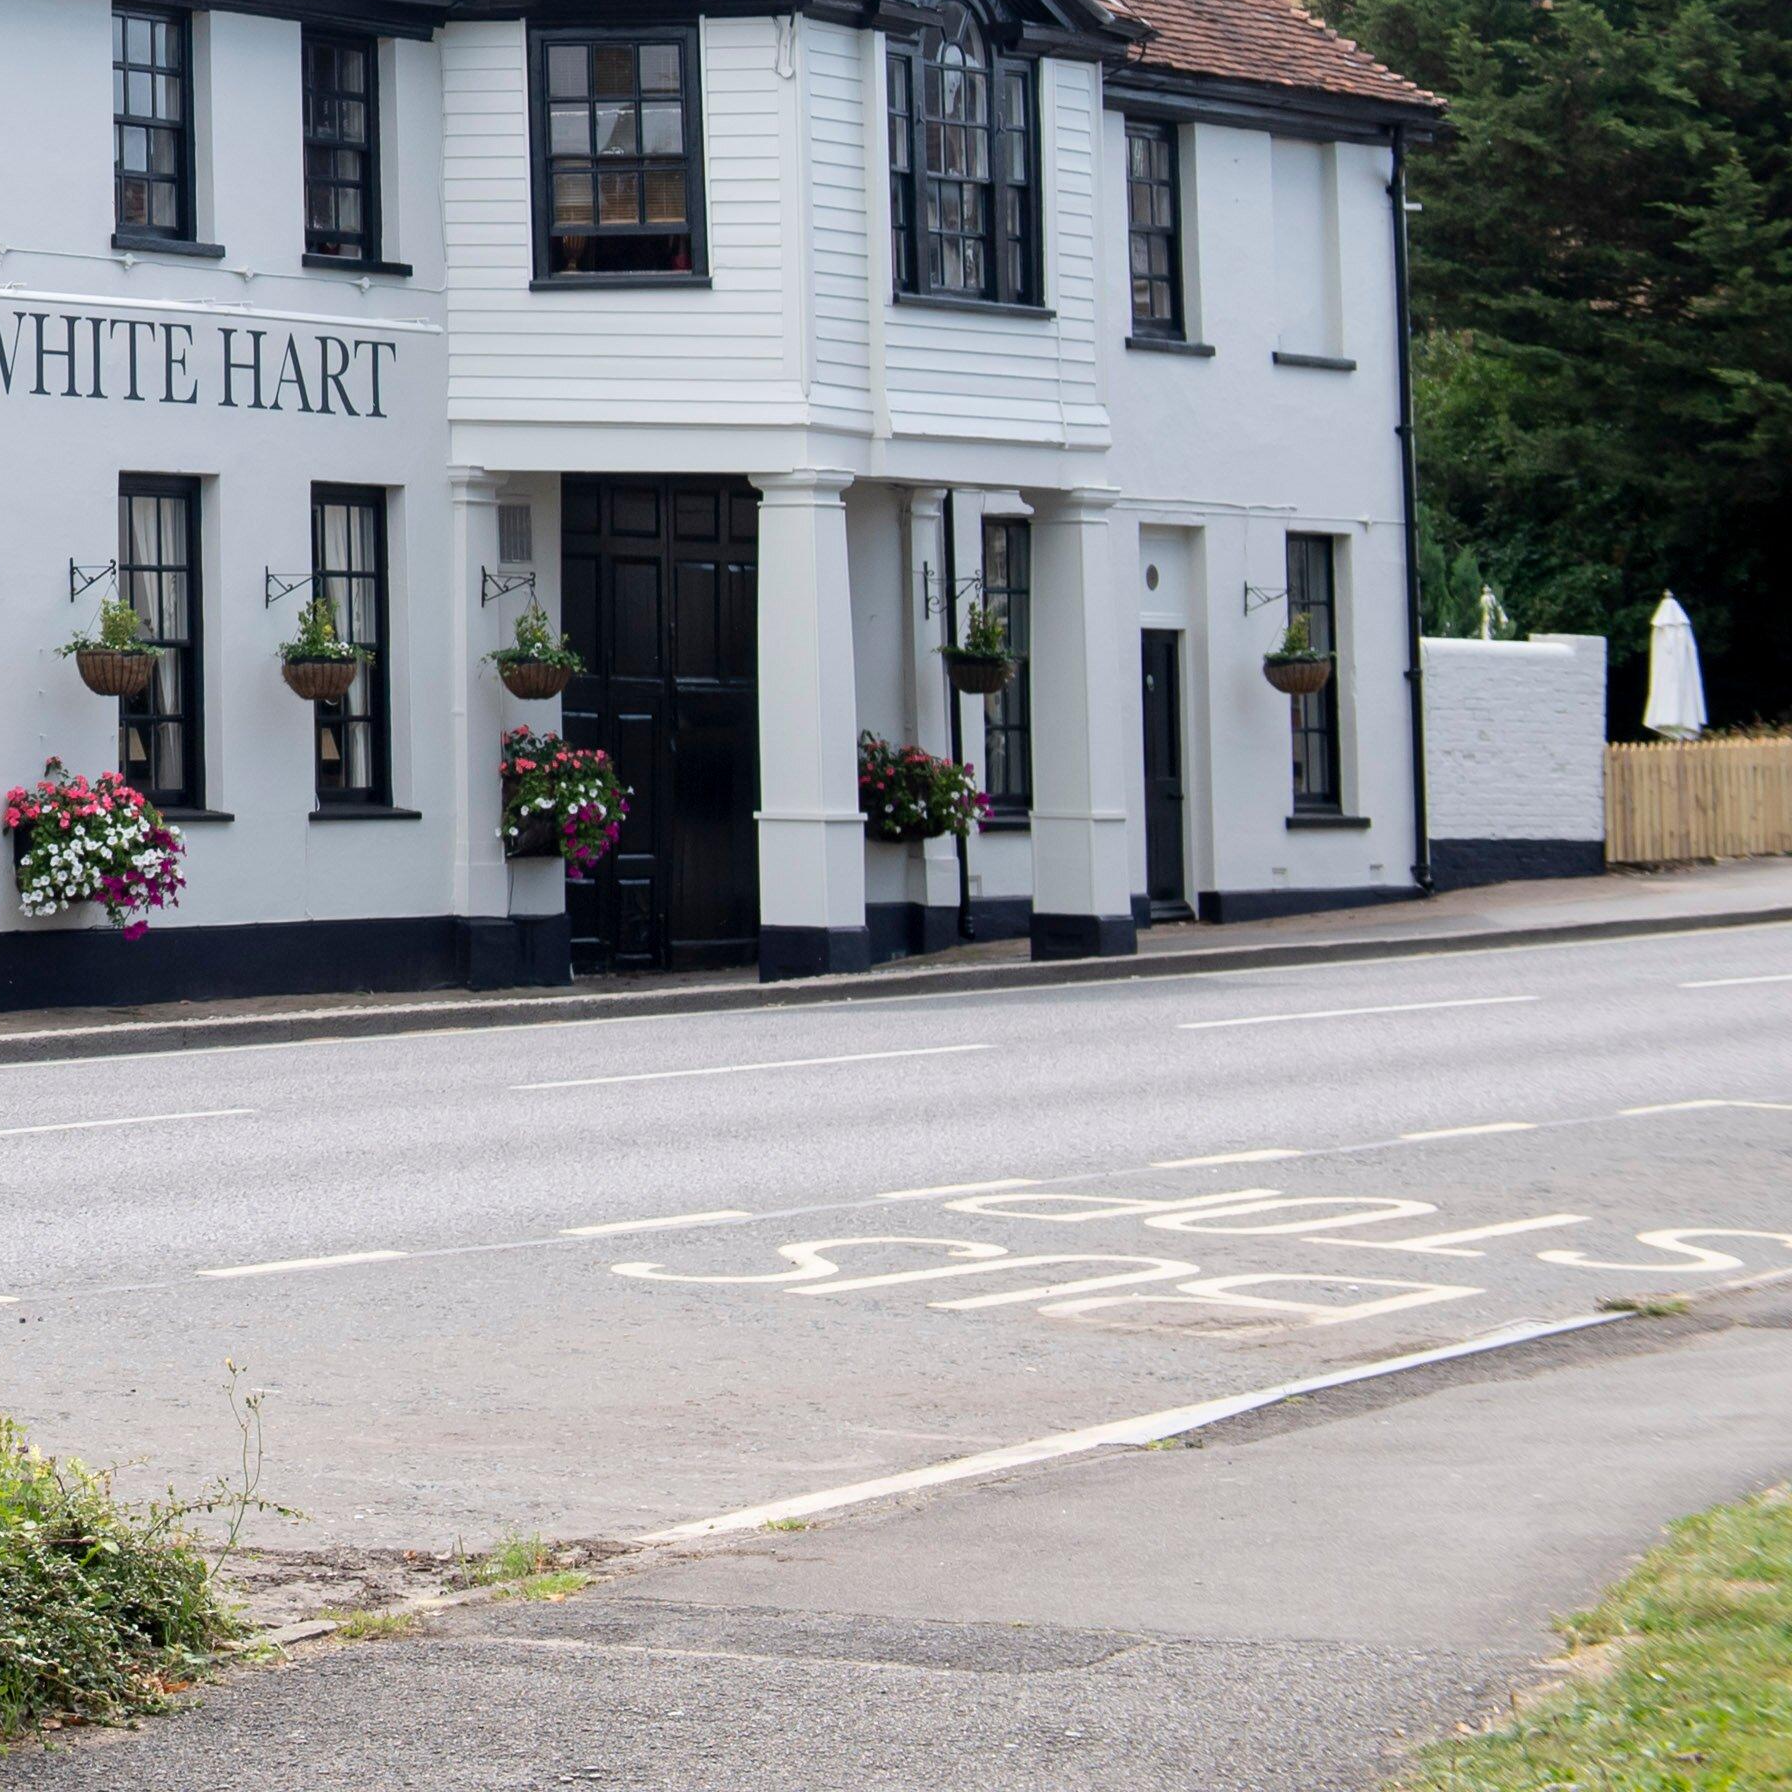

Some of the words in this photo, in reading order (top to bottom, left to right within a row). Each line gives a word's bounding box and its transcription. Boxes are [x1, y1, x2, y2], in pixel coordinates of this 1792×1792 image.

[217, 326, 397, 418] HART
[944, 1188, 1792, 1272] STOP
[610, 1237, 1487, 1338] BUS
